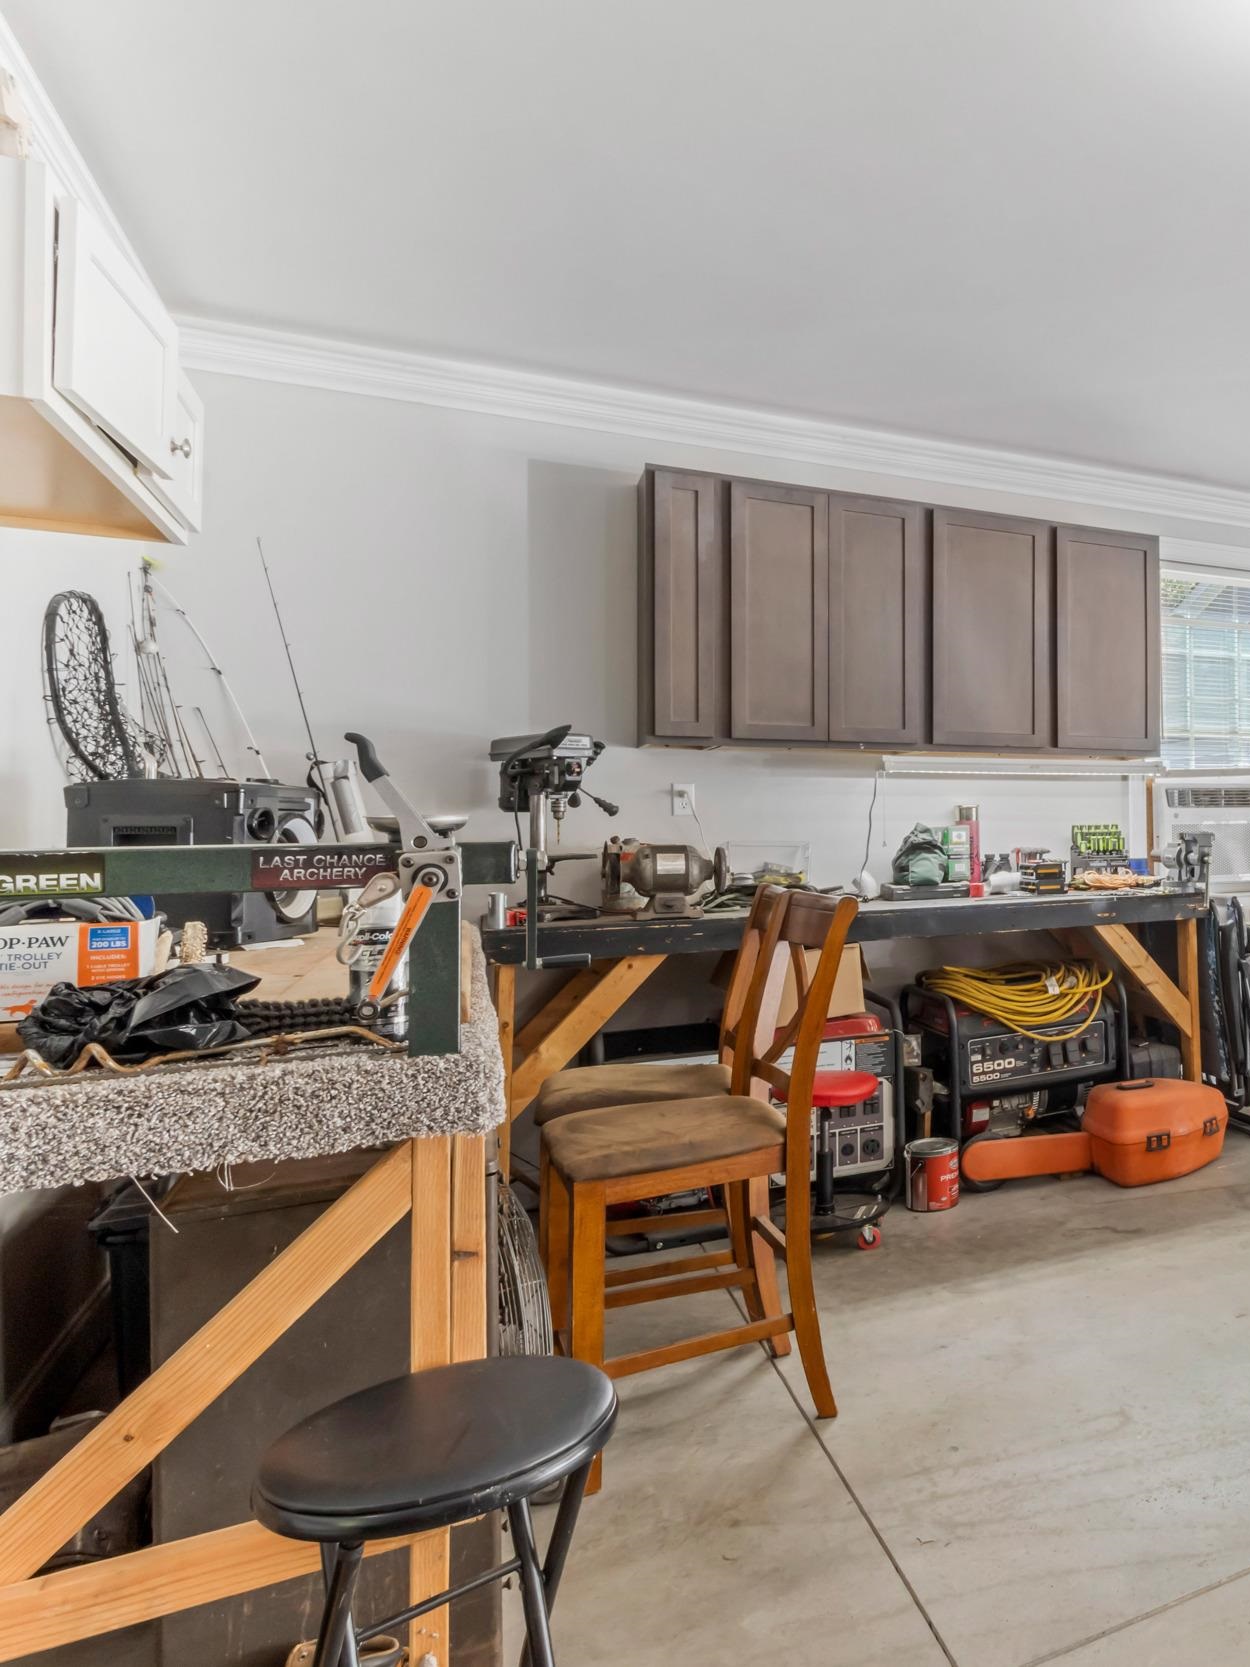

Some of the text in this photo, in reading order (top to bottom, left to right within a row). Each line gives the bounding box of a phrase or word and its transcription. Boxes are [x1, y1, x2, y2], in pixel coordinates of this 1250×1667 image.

[259, 854, 387, 868] LAST CHANCE
[280, 867, 367, 881] ARCHERY
[0, 872, 102, 893] GREEN
[7, 952, 62, 961] TROLLEY
[972, 1058, 1016, 1073] 6500
[972, 1073, 1000, 1083] 5500
